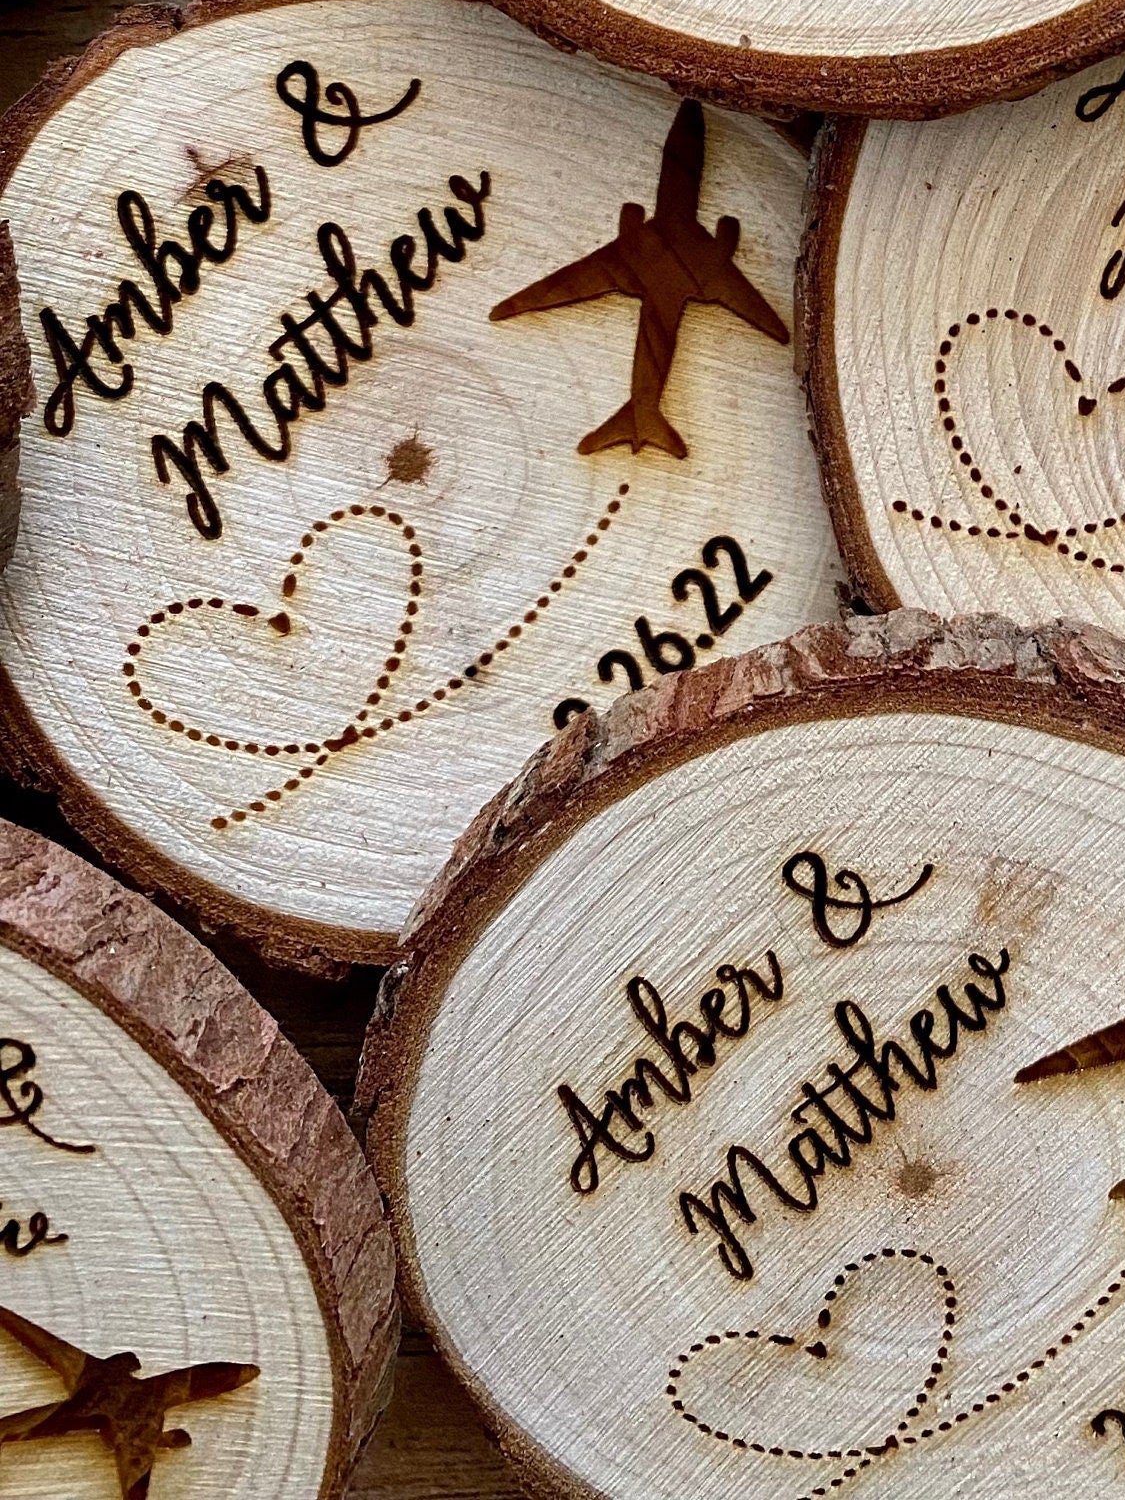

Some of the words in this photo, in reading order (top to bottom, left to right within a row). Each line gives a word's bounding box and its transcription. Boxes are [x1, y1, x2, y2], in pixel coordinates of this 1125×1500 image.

[37, 164, 273, 438] Amber
[275, 60, 422, 167] &
[150, 170, 492, 540] Matthew
[557, 948, 784, 1195] Amber
[782, 850, 934, 949] &
[679, 948, 1010, 1282] Matthew
